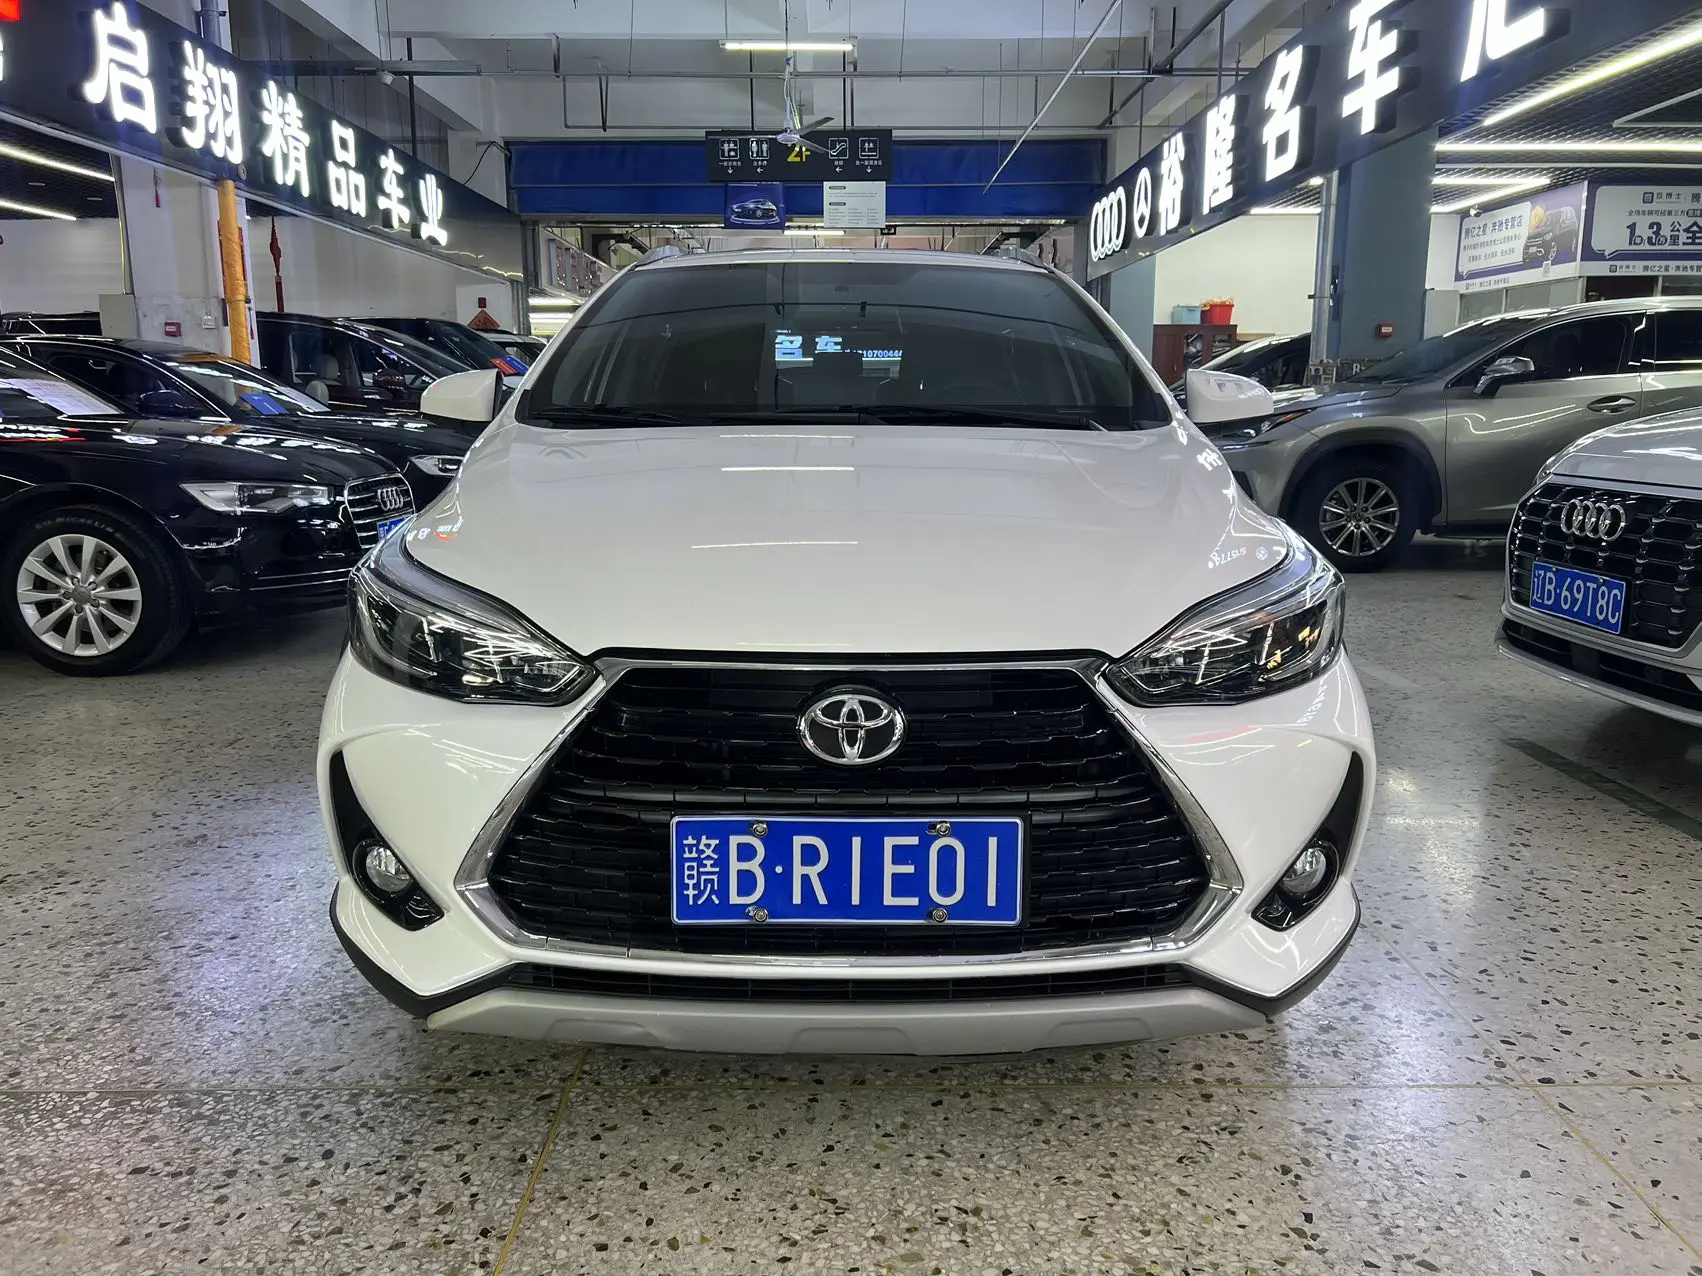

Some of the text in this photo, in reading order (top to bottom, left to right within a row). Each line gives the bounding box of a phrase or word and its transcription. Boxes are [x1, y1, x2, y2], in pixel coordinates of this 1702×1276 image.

[84, 2, 448, 247] 启翔精品车业
[683, 834, 998, 907] 赣B·R1E01
